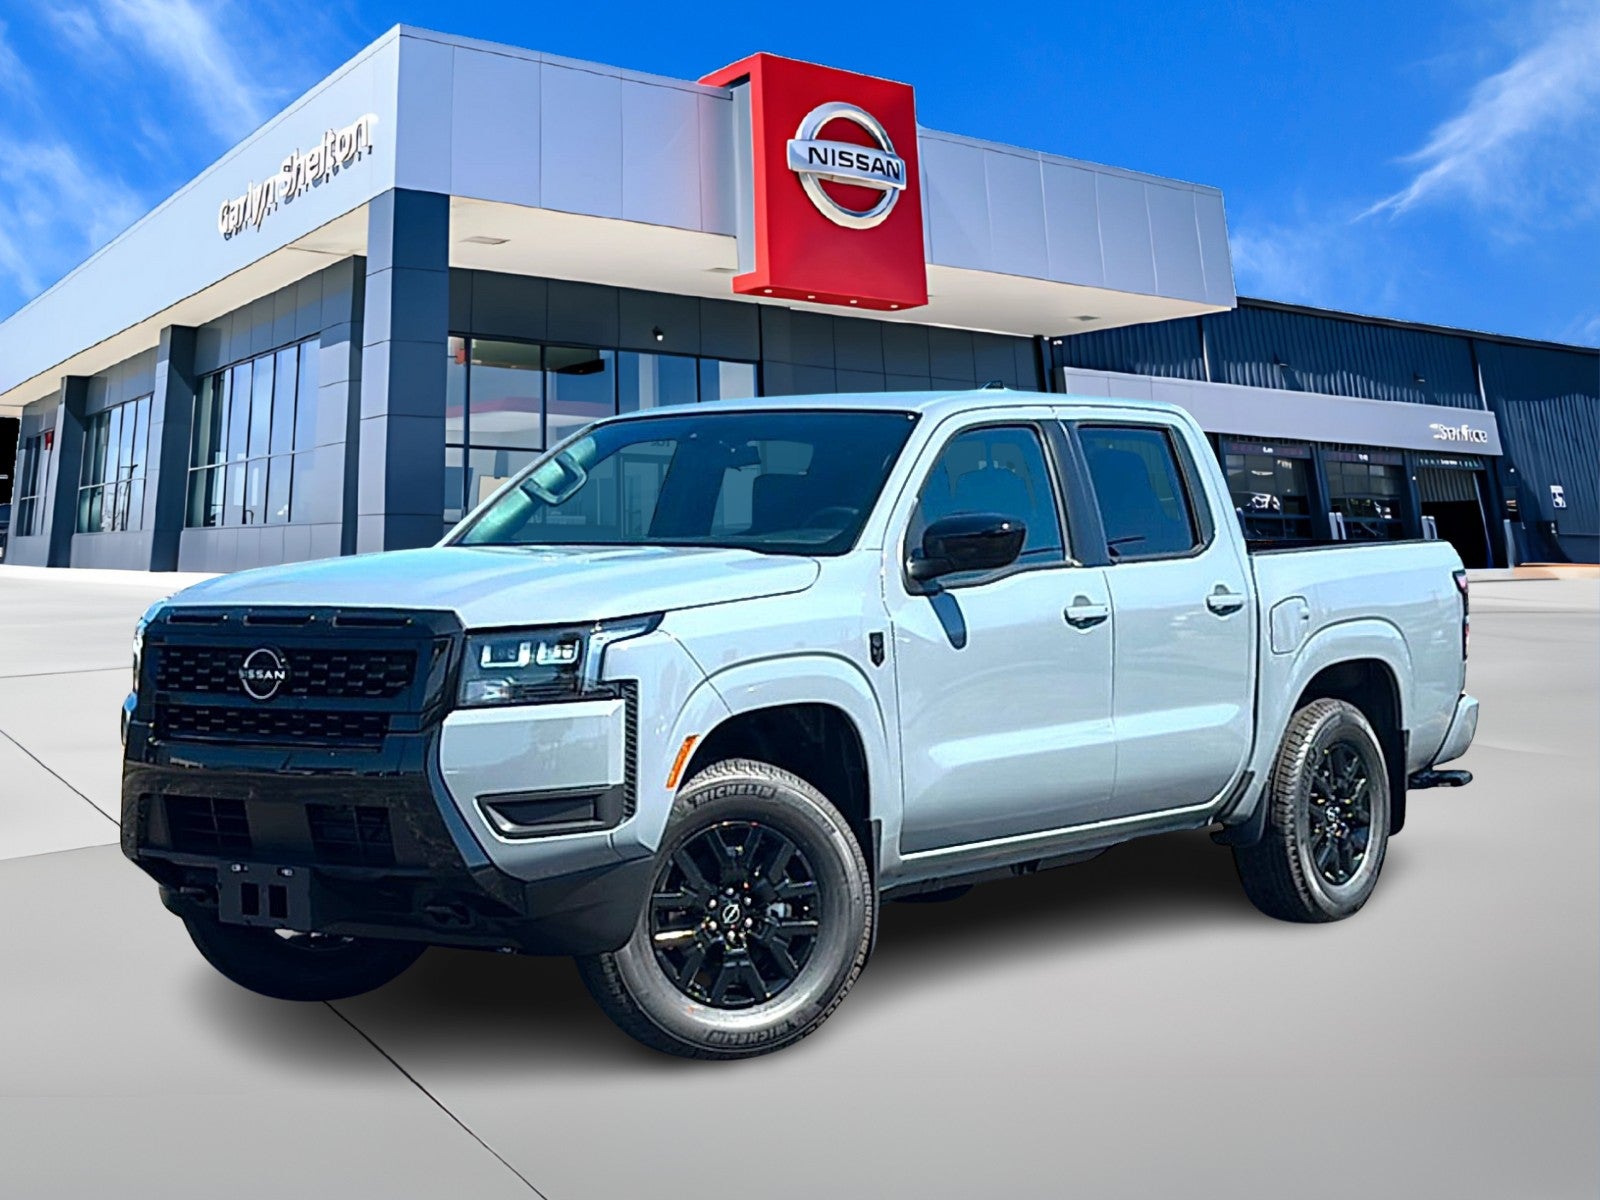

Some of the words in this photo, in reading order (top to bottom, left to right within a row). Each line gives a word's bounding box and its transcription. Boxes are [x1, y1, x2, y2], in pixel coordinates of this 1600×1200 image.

[277, 114, 376, 203] Shelton
[808, 146, 901, 180] NISSAN
[239, 669, 286, 680] NISSAN
[694, 783, 775, 806] MICHELIN
